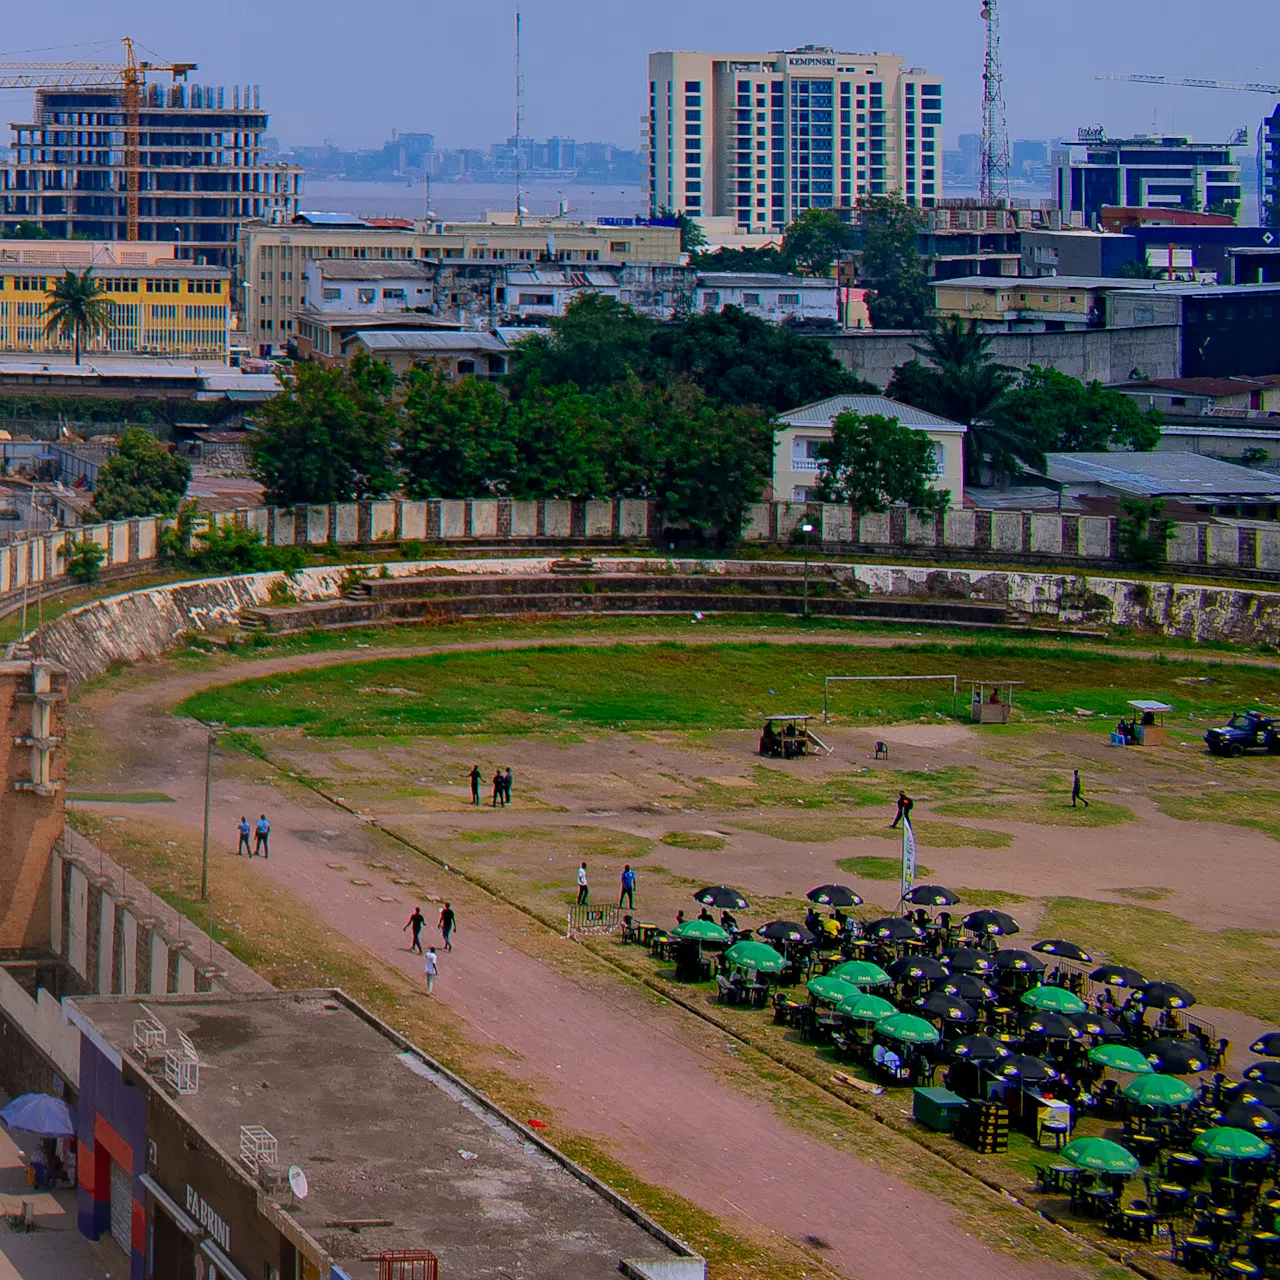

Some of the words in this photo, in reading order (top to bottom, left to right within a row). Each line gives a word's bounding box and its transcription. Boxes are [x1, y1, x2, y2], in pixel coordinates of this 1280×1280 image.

[789, 57, 836, 66] KEMPINSKI
[1077, 124, 1104, 137] Ecobank
[186, 1184, 230, 1253] FABRINI
